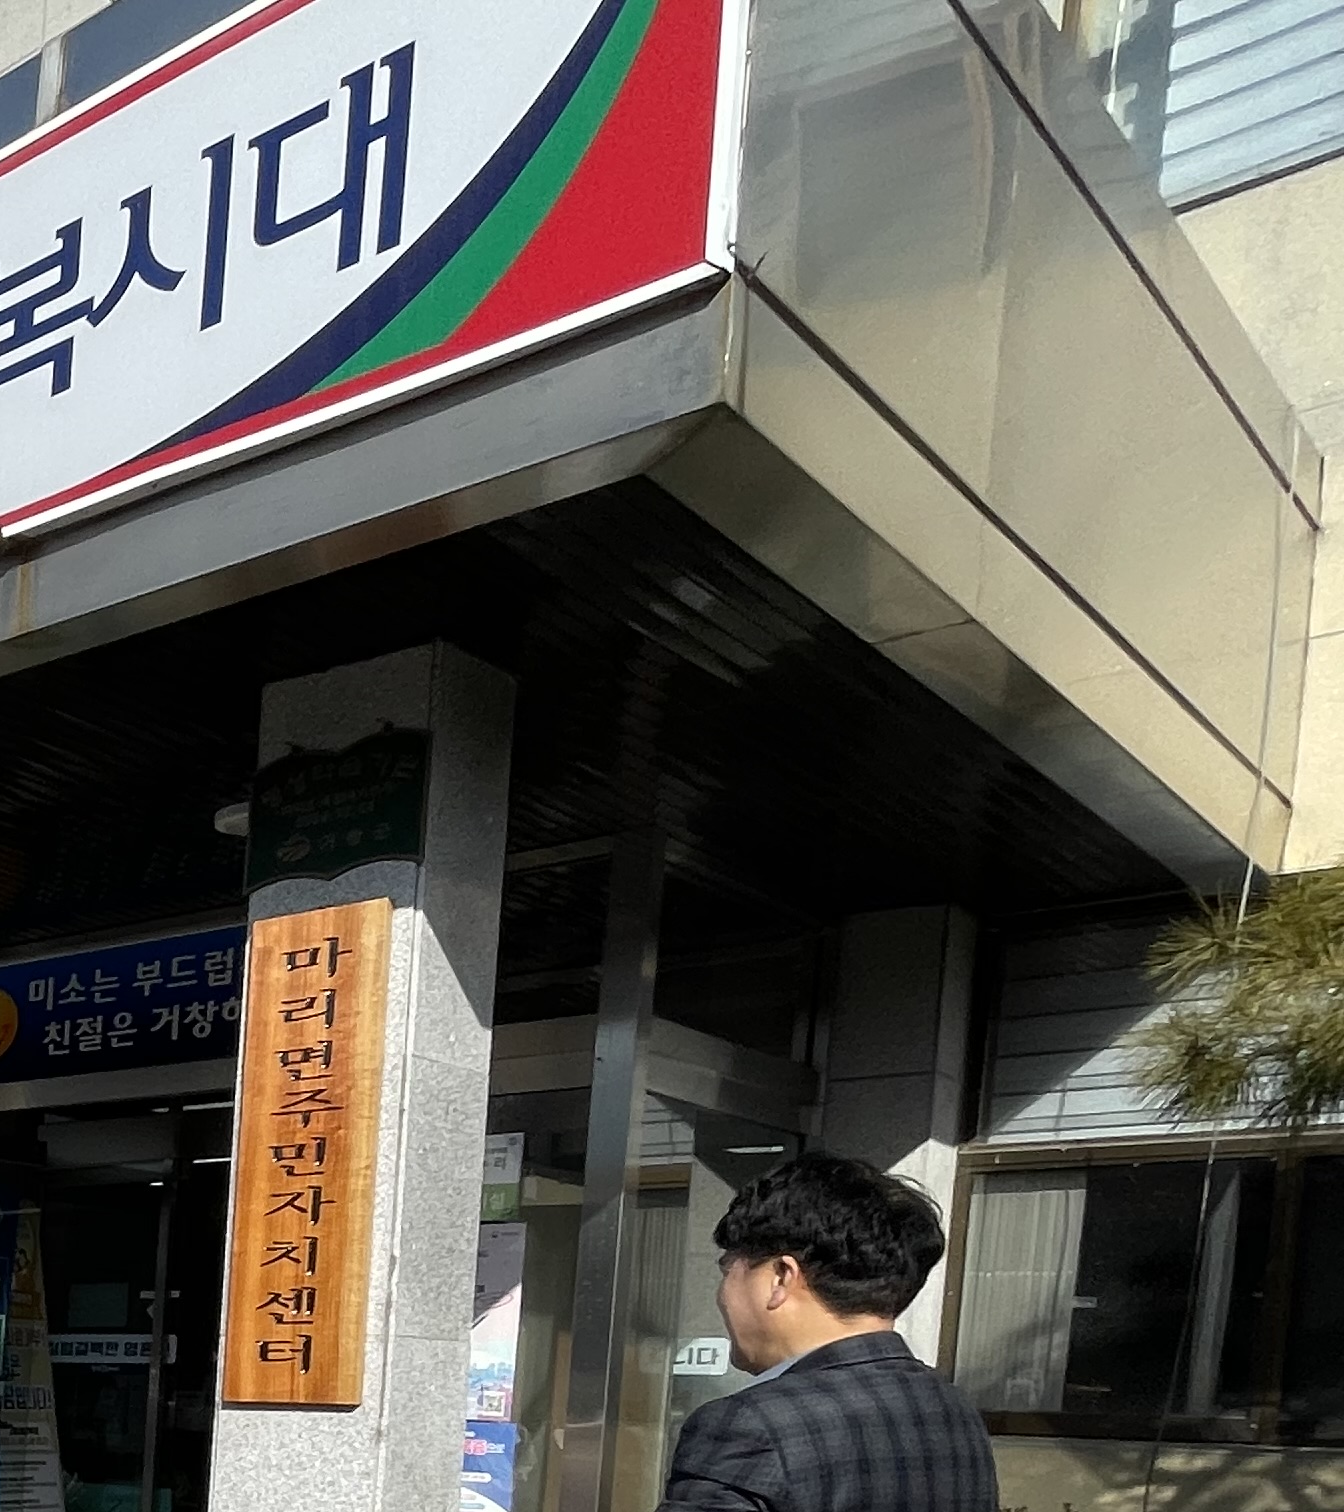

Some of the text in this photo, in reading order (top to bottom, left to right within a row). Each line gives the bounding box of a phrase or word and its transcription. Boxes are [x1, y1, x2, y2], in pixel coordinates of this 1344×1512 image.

[28, 948, 244, 1011] 미소는 부드럽
[43, 1012, 139, 1056] 친절은
[254, 936, 353, 1376] 마리면주민자치센터
